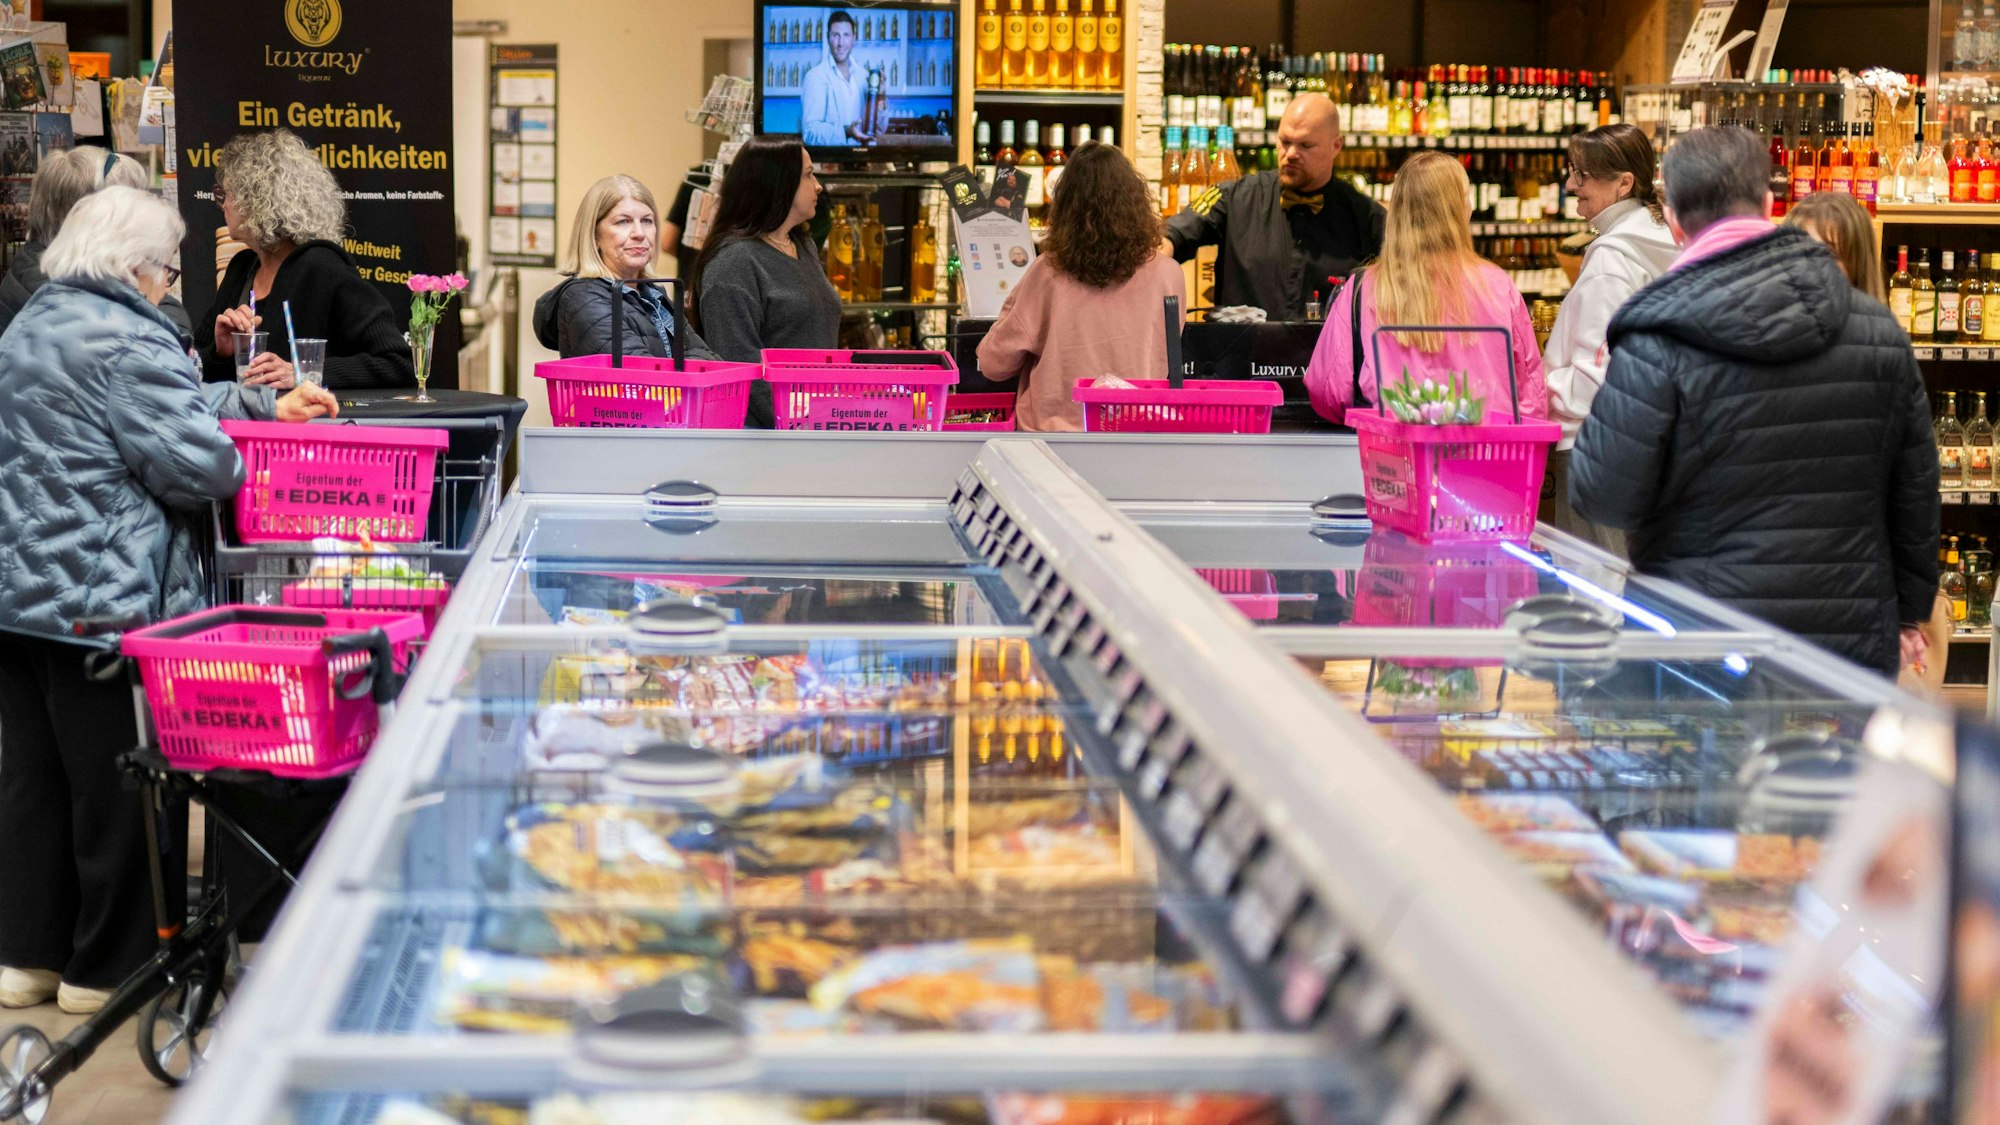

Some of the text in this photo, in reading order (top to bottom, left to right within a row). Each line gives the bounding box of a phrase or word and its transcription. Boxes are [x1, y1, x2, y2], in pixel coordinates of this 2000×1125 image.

[238, 101, 401, 133] Ein Getränk,
[187, 142, 447, 170] vie lichkeiten
[355, 191, 386, 201] Aromen,
[386, 191, 407, 200] keine
[344, 238, 401, 260] Weltweit
[356, 265, 373, 280] er
[1251, 362, 1298, 377] Luxury
[594, 407, 643, 420] Eigentum der
[831, 407, 888, 420] Eigentum der
[296, 472, 363, 487] Eigentum der
[289, 489, 371, 507] EDEKA
[195, 710, 269, 731] EDEKA
